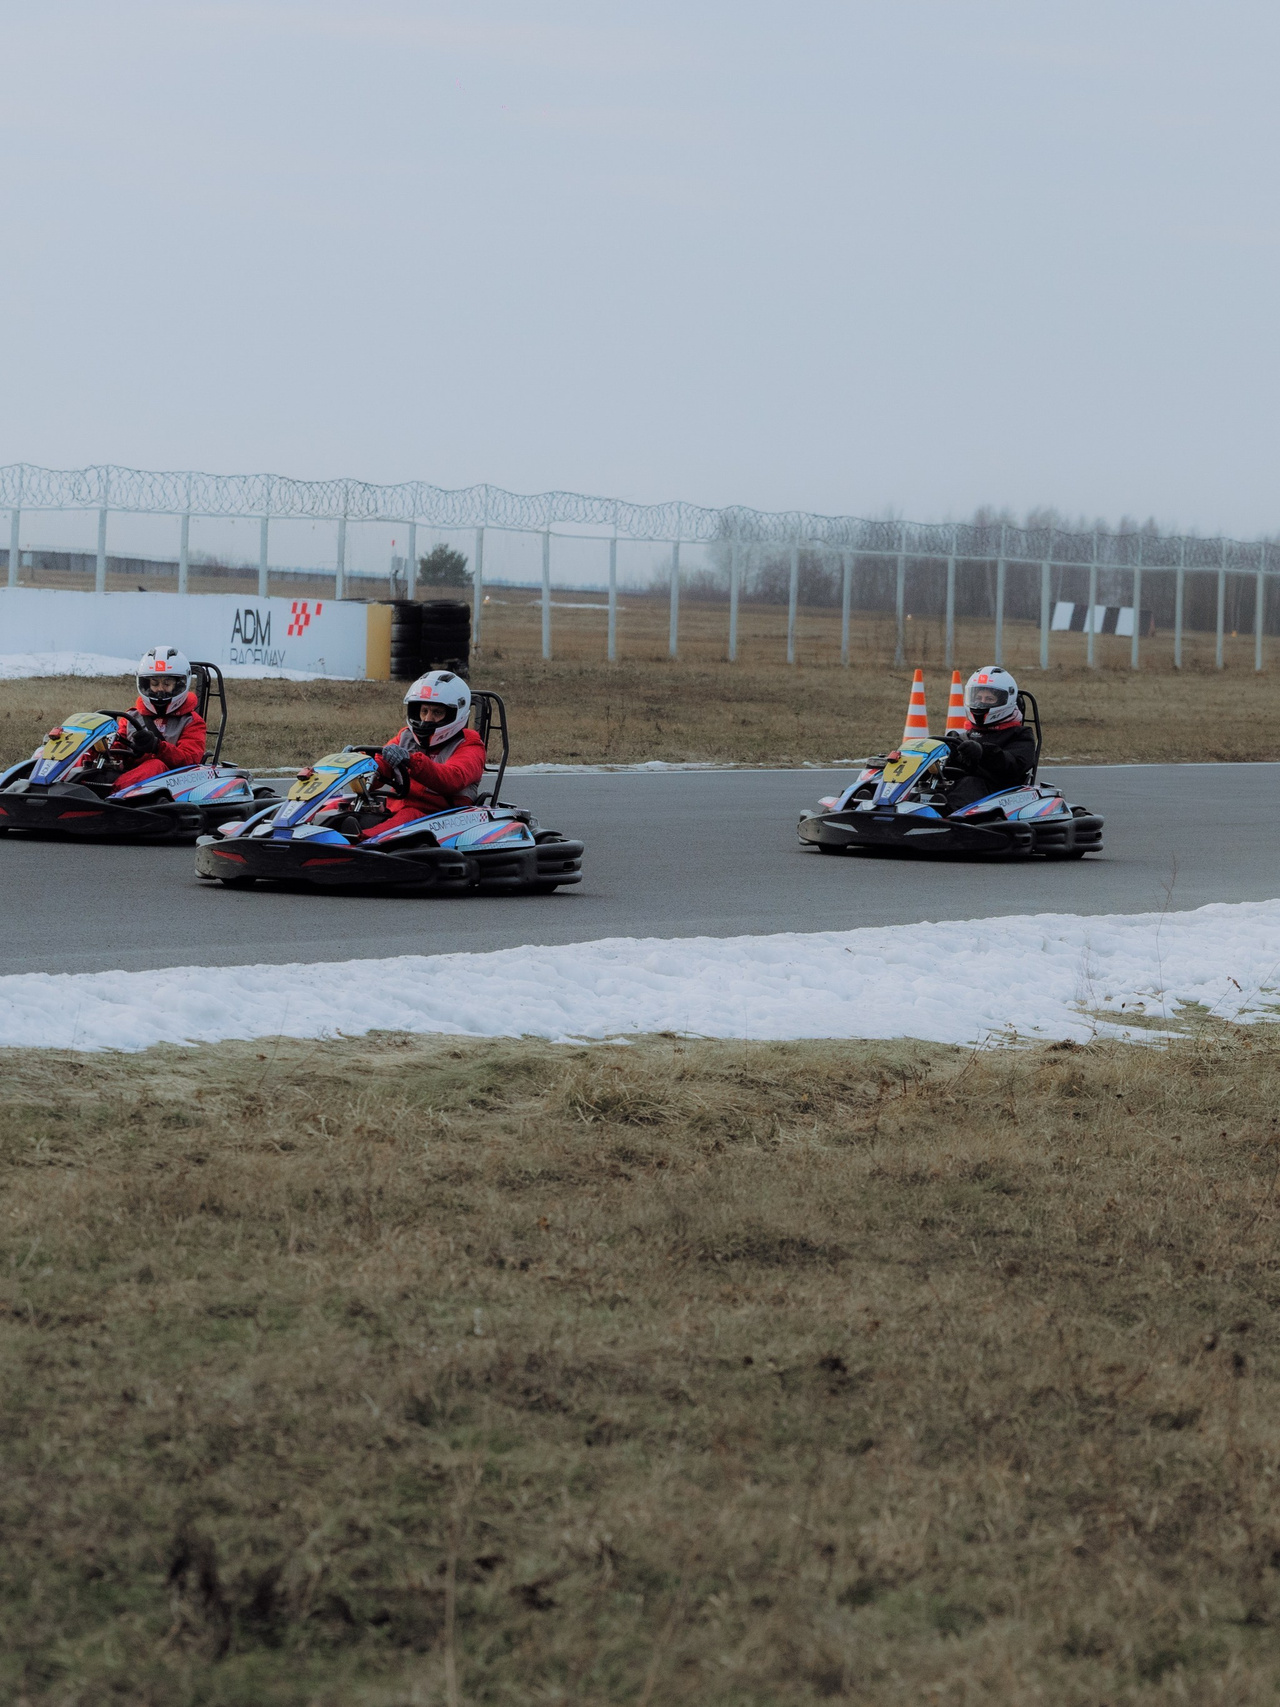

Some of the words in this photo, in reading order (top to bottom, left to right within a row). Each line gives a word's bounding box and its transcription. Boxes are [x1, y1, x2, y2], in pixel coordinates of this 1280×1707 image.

[231, 609, 271, 646] ADM
[51, 740, 74, 754] 17
[893, 764, 905, 777] 4
[296, 781, 323, 795] 18
